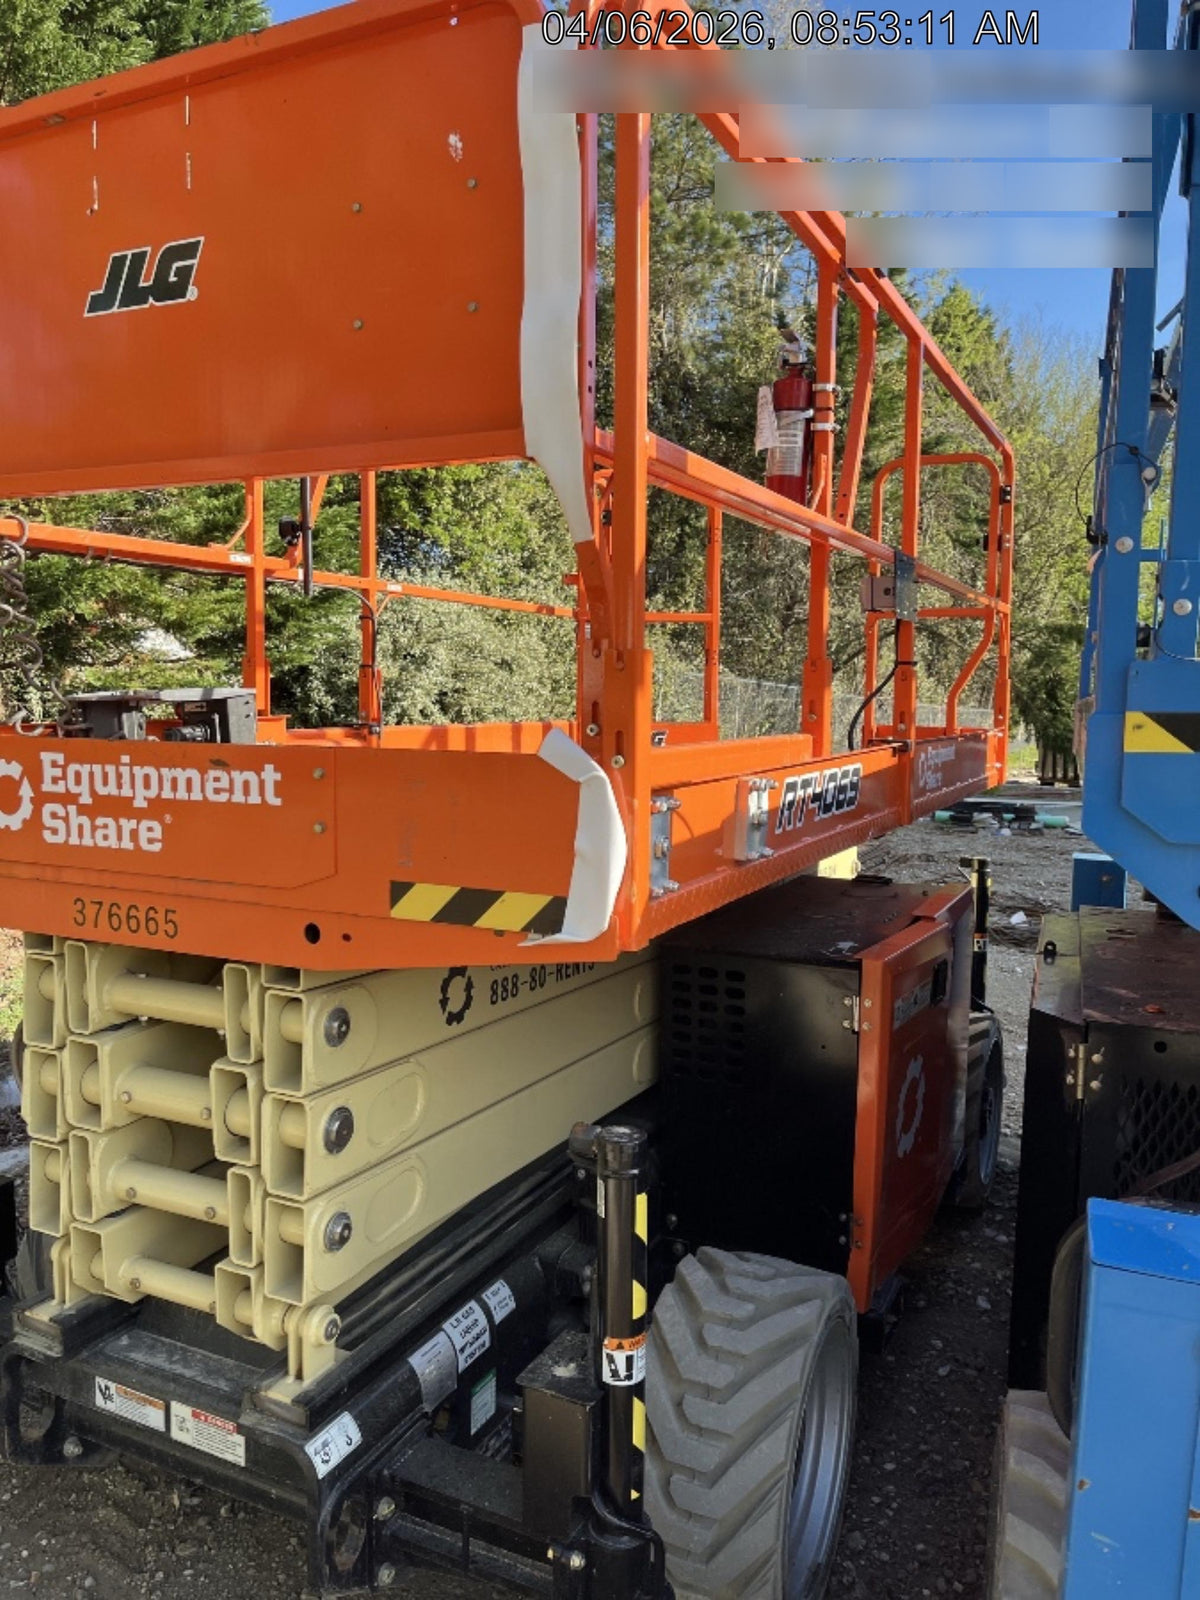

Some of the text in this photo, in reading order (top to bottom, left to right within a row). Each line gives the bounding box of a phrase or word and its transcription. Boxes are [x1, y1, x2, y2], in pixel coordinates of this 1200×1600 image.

[84, 236, 204, 317] JLG
[40, 751, 282, 807] Equipment
[775, 763, 863, 835] RT4069
[41, 803, 163, 852] Share
[73, 897, 179, 939] 376665
